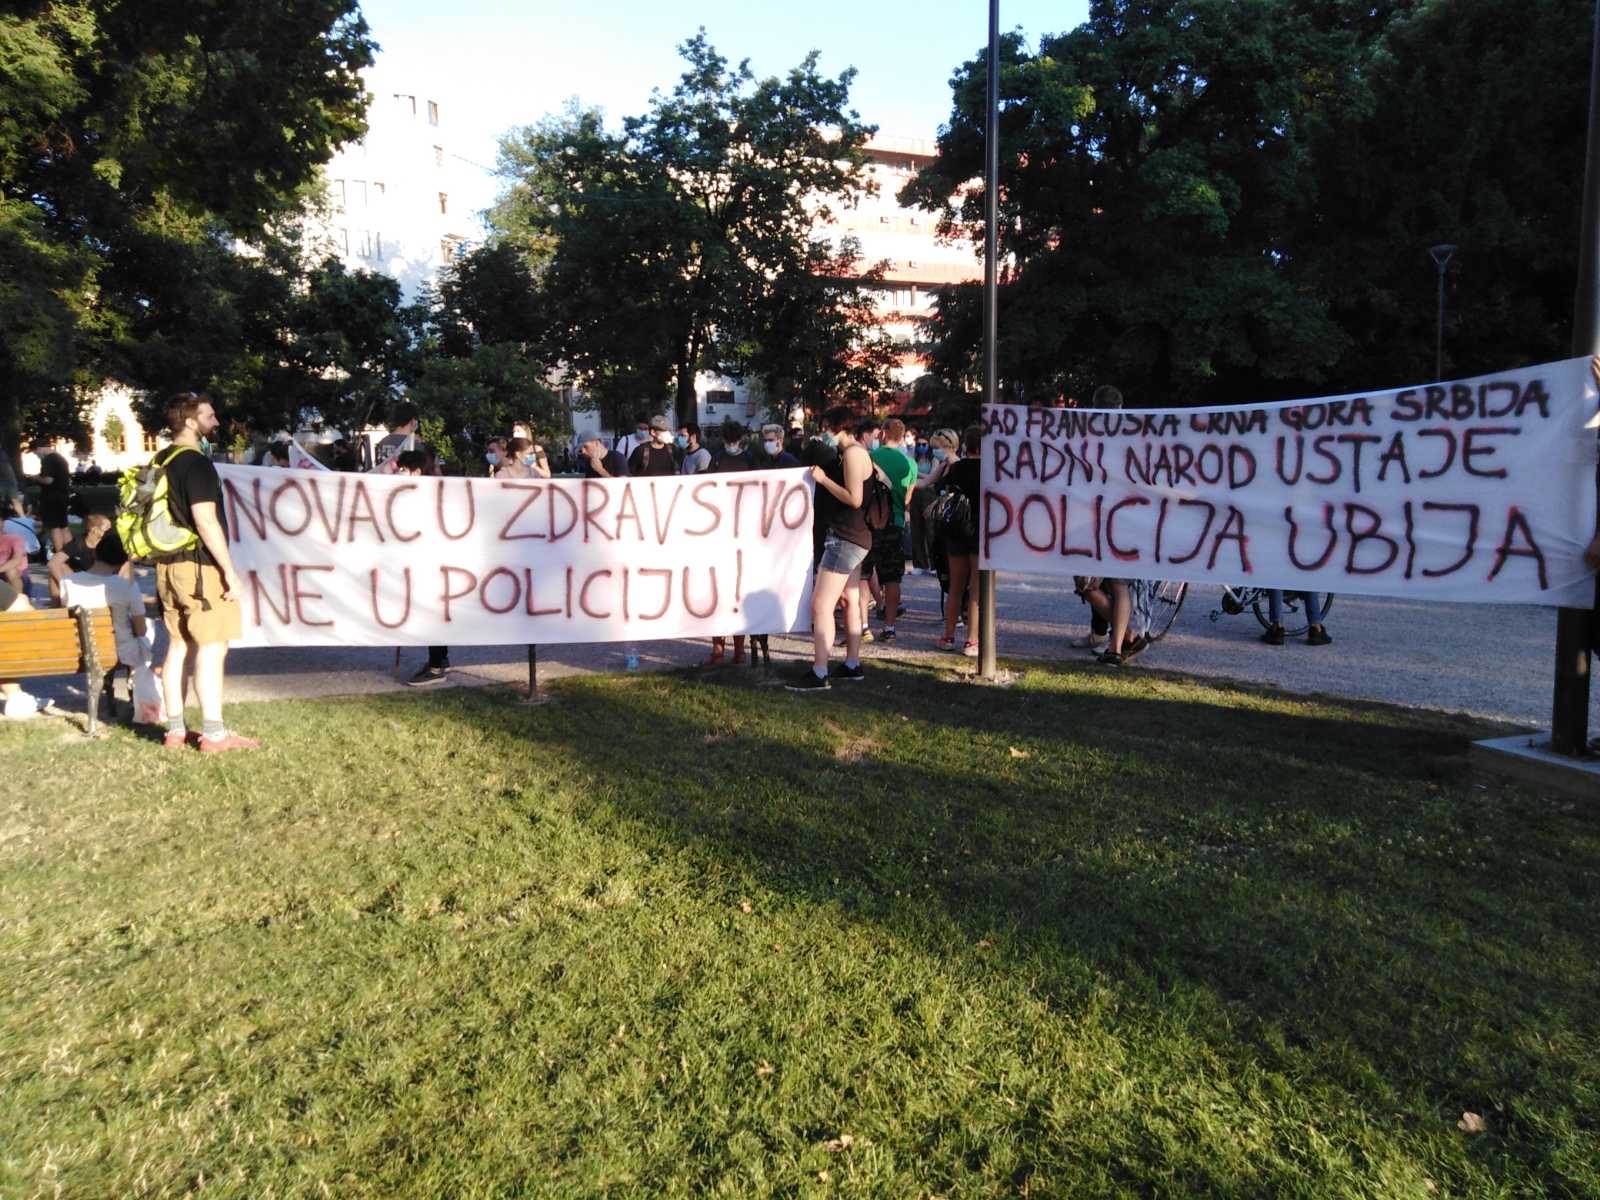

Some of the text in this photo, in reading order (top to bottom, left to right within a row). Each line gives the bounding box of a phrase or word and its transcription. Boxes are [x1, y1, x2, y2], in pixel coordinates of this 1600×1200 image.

[980, 407, 1018, 436] SAD
[1026, 406, 1181, 440] FRANCUSKA
[1280, 397, 1374, 431] GORA
[1390, 379, 1550, 422] SRBIJA
[993, 427, 1522, 493] RADNI NAROD USTAJE
[222, 477, 811, 545] NOVAC U ZDRAVSTVO
[983, 490, 1549, 590] POLICIJA UBIJA
[248, 549, 743, 629] NE U POLICIJU!
